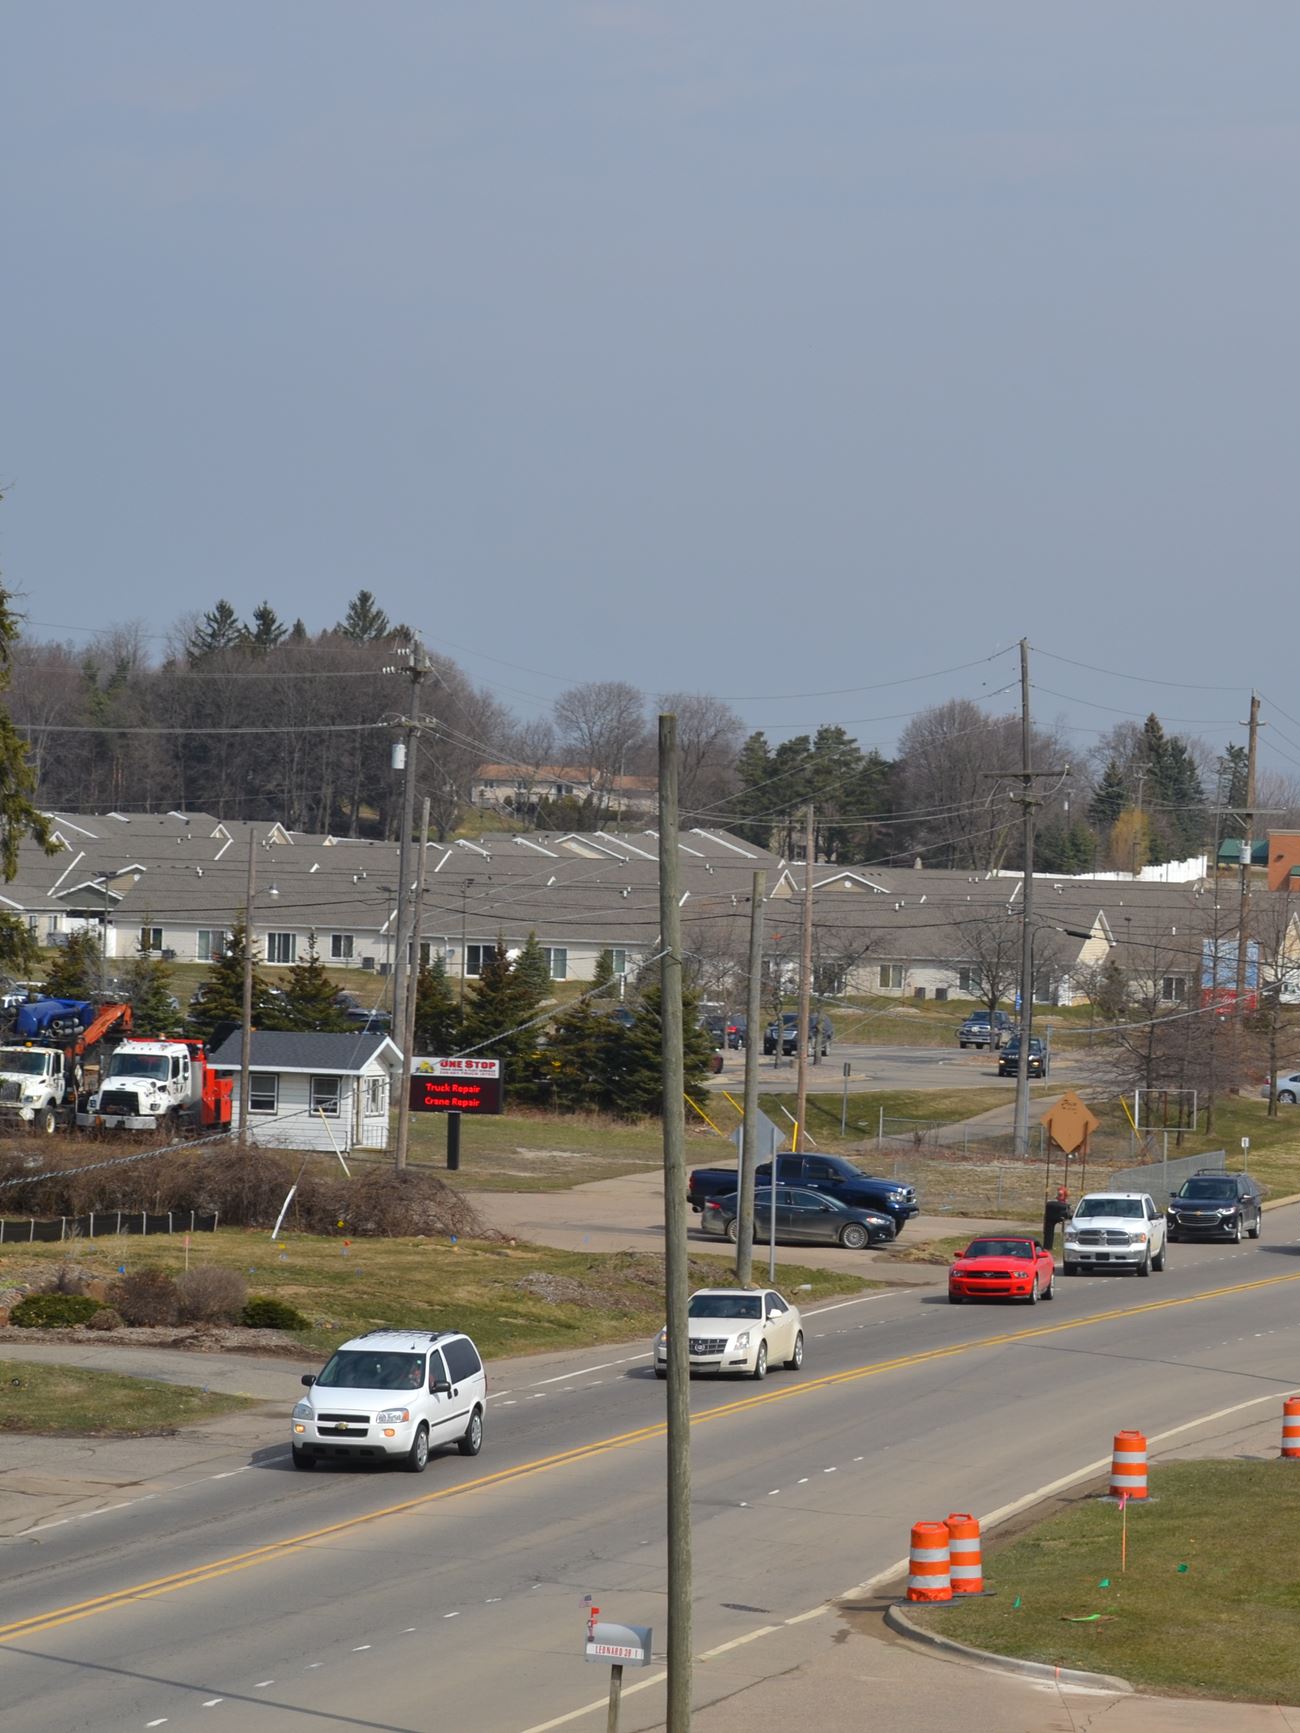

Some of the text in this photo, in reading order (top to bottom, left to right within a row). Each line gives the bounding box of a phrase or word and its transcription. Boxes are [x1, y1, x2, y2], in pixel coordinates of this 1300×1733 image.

[440, 1059, 496, 1069] ONE STOP
[425, 1083, 480, 1095] Truck Repair
[424, 1097, 480, 1108] Crane Repair
[595, 1645, 622, 1657] LEONARD
